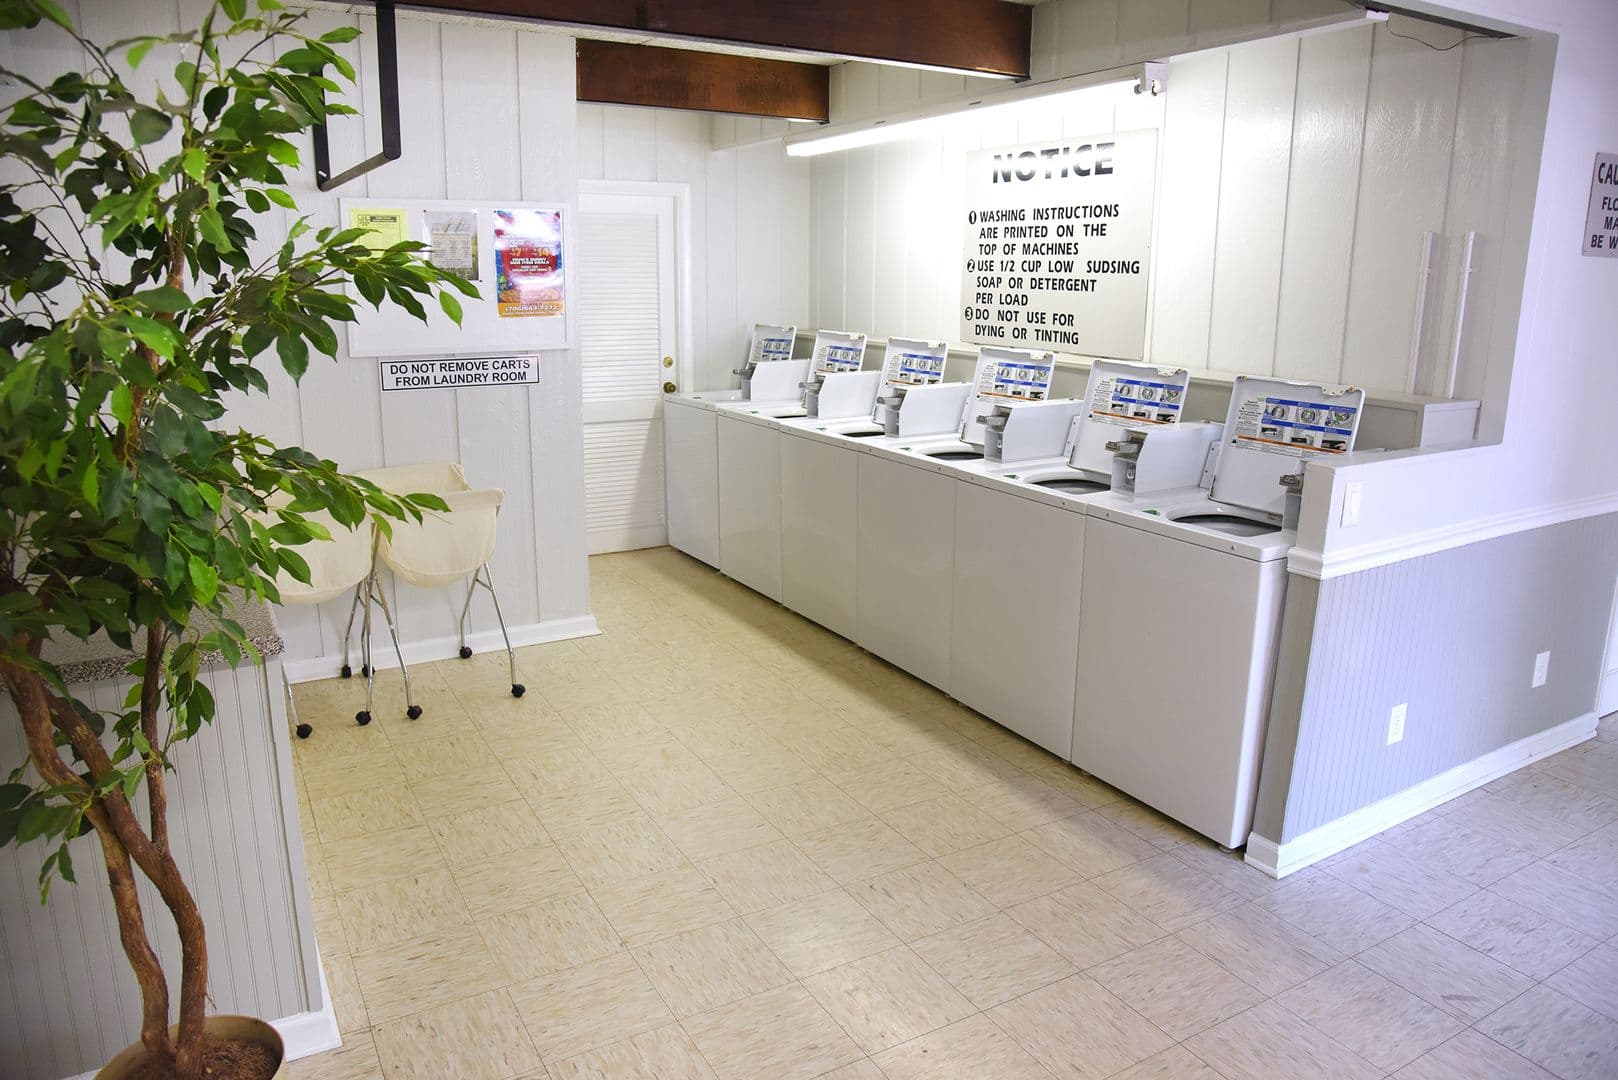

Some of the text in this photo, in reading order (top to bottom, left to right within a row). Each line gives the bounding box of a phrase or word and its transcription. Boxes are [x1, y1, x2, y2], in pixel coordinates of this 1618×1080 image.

[993, 142, 1115, 183] NOTICE
[980, 209, 1025, 222] WASHING
[1033, 204, 1119, 220] INSTRUCTIONS
[979, 224, 1107, 239] ARE PRINTED ON THE
[1591, 234, 1604, 248] BE
[979, 243, 1079, 255] TOP OF MACHINES
[978, 260, 994, 272] USE
[1000, 261, 1015, 272] 1/2
[1021, 261, 1041, 272] CUP
[1049, 261, 1074, 272] LOW
[1086, 261, 1140, 274] SUDSING
[976, 277, 1097, 292] SOAP OR DETERGENT
[976, 293, 1028, 306] PER LOAD
[976, 309, 989, 320] DO
[997, 310, 1019, 322] NOT
[1027, 312, 1046, 324] USE
[1053, 314, 1074, 326] FOR
[975, 325, 1079, 345] DYING OR TINTING
[391, 360, 530, 374] DO NOT REMOVE CARTS
[396, 372, 526, 386] FROM LAUNDRY ROOM
